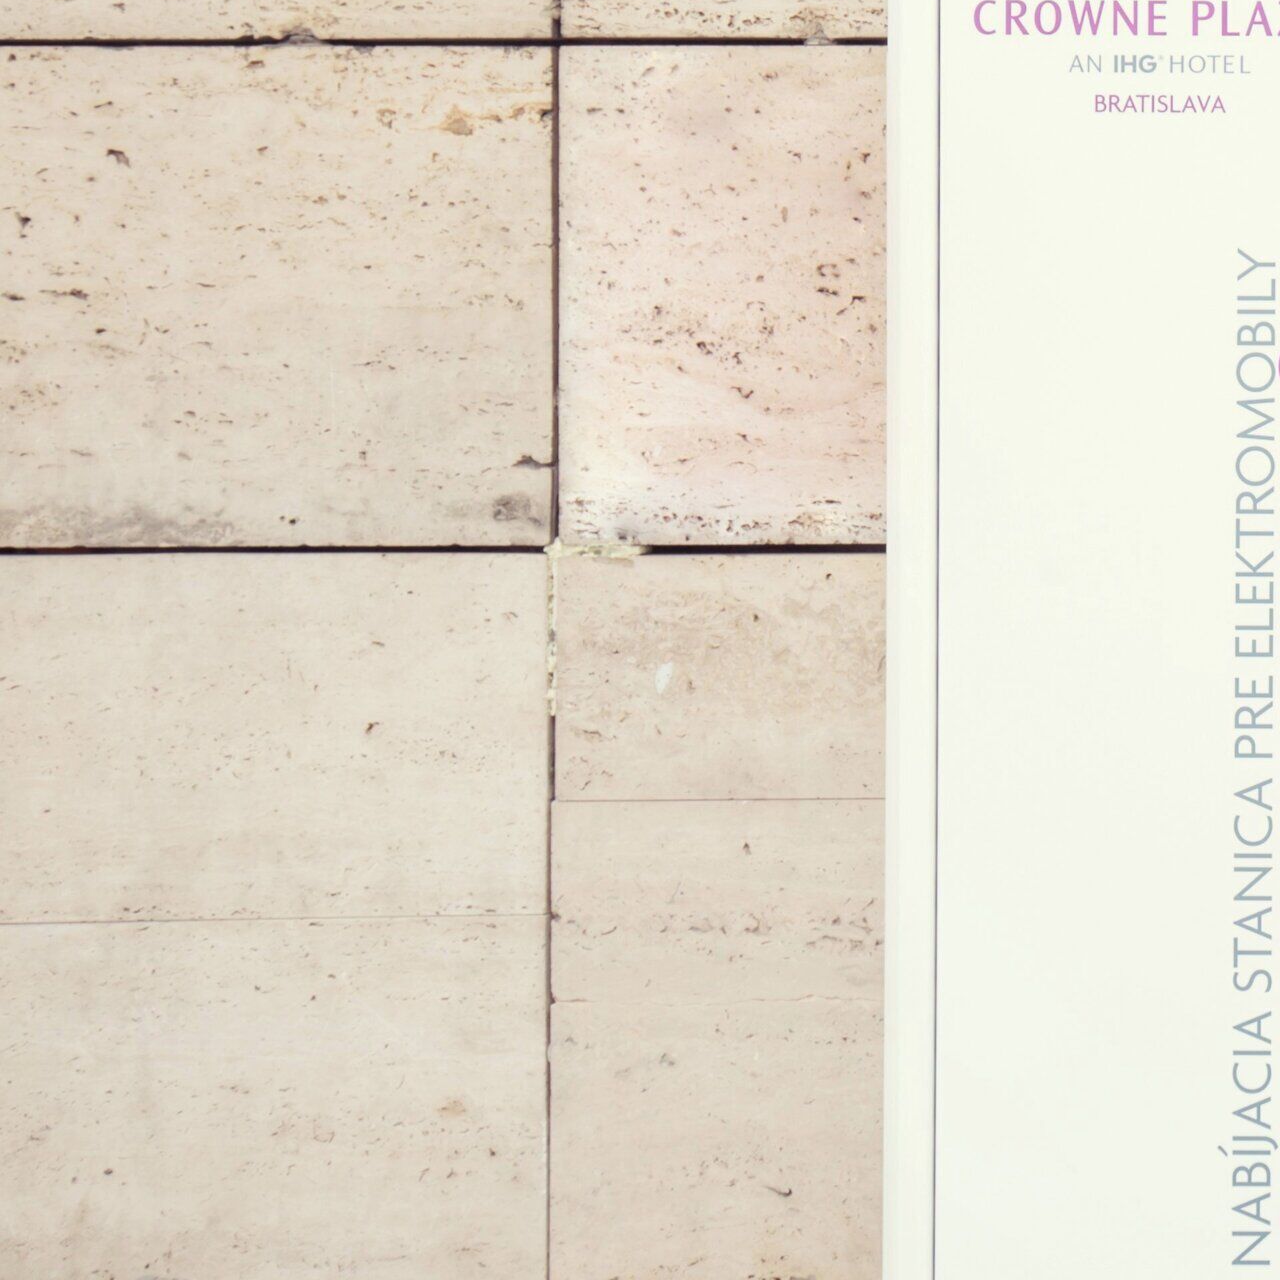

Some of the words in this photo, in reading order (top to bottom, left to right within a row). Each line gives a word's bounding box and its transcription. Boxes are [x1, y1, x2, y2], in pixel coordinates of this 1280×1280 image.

[973, 0, 1169, 37] CROWNE
[1069, 55, 1103, 74] AN
[1169, 55, 1251, 75] HOTEL
[1094, 94, 1227, 115] BRATISLAVA
[1235, 249, 1277, 659] ELEKTROMOBILY
[1234, 676, 1275, 760] PRE
[1233, 778, 1274, 994] STANICA
[1217, 1010, 1279, 1267] NABÍJACIA
